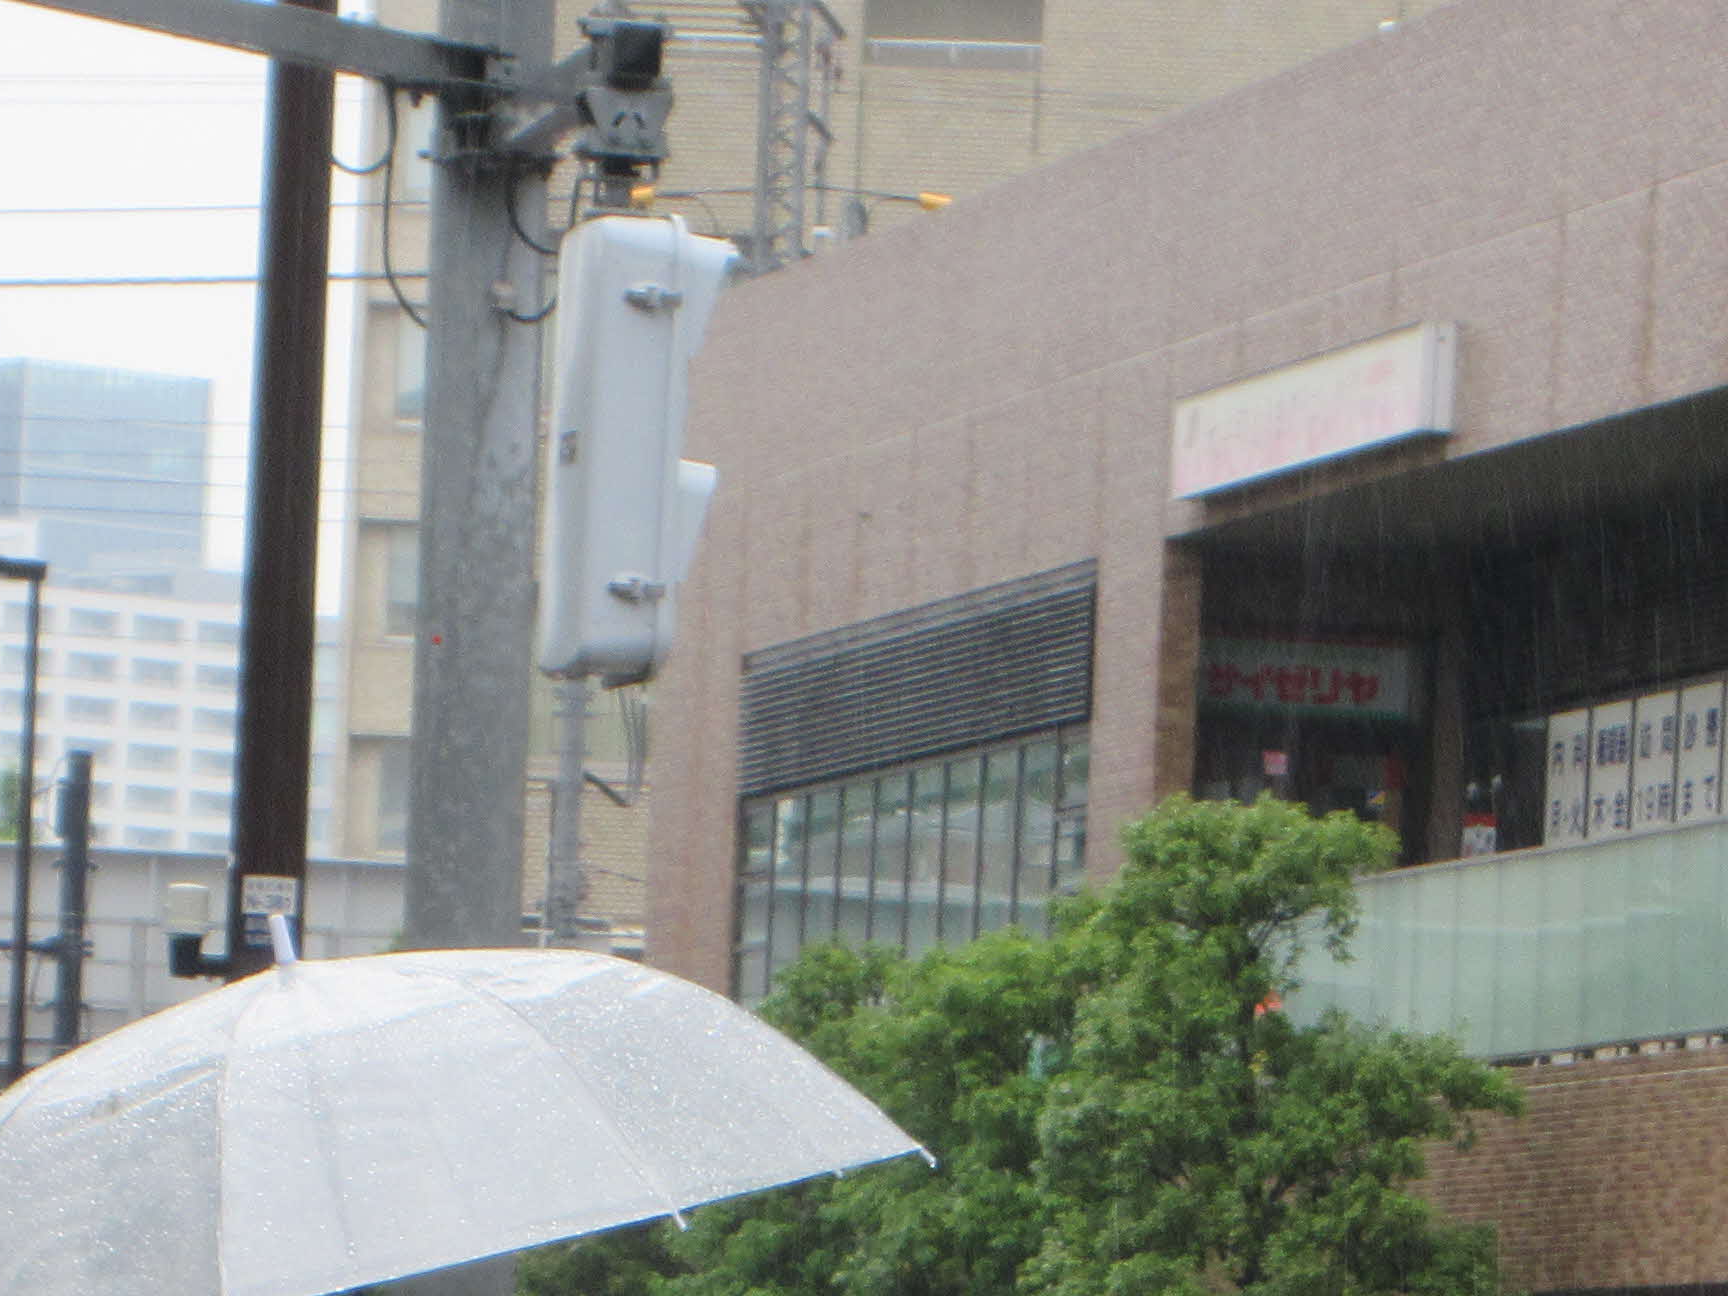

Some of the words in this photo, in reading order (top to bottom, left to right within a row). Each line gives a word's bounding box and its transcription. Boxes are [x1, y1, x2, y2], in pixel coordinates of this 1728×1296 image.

[1205, 661, 1379, 704] サイゼリヤ
